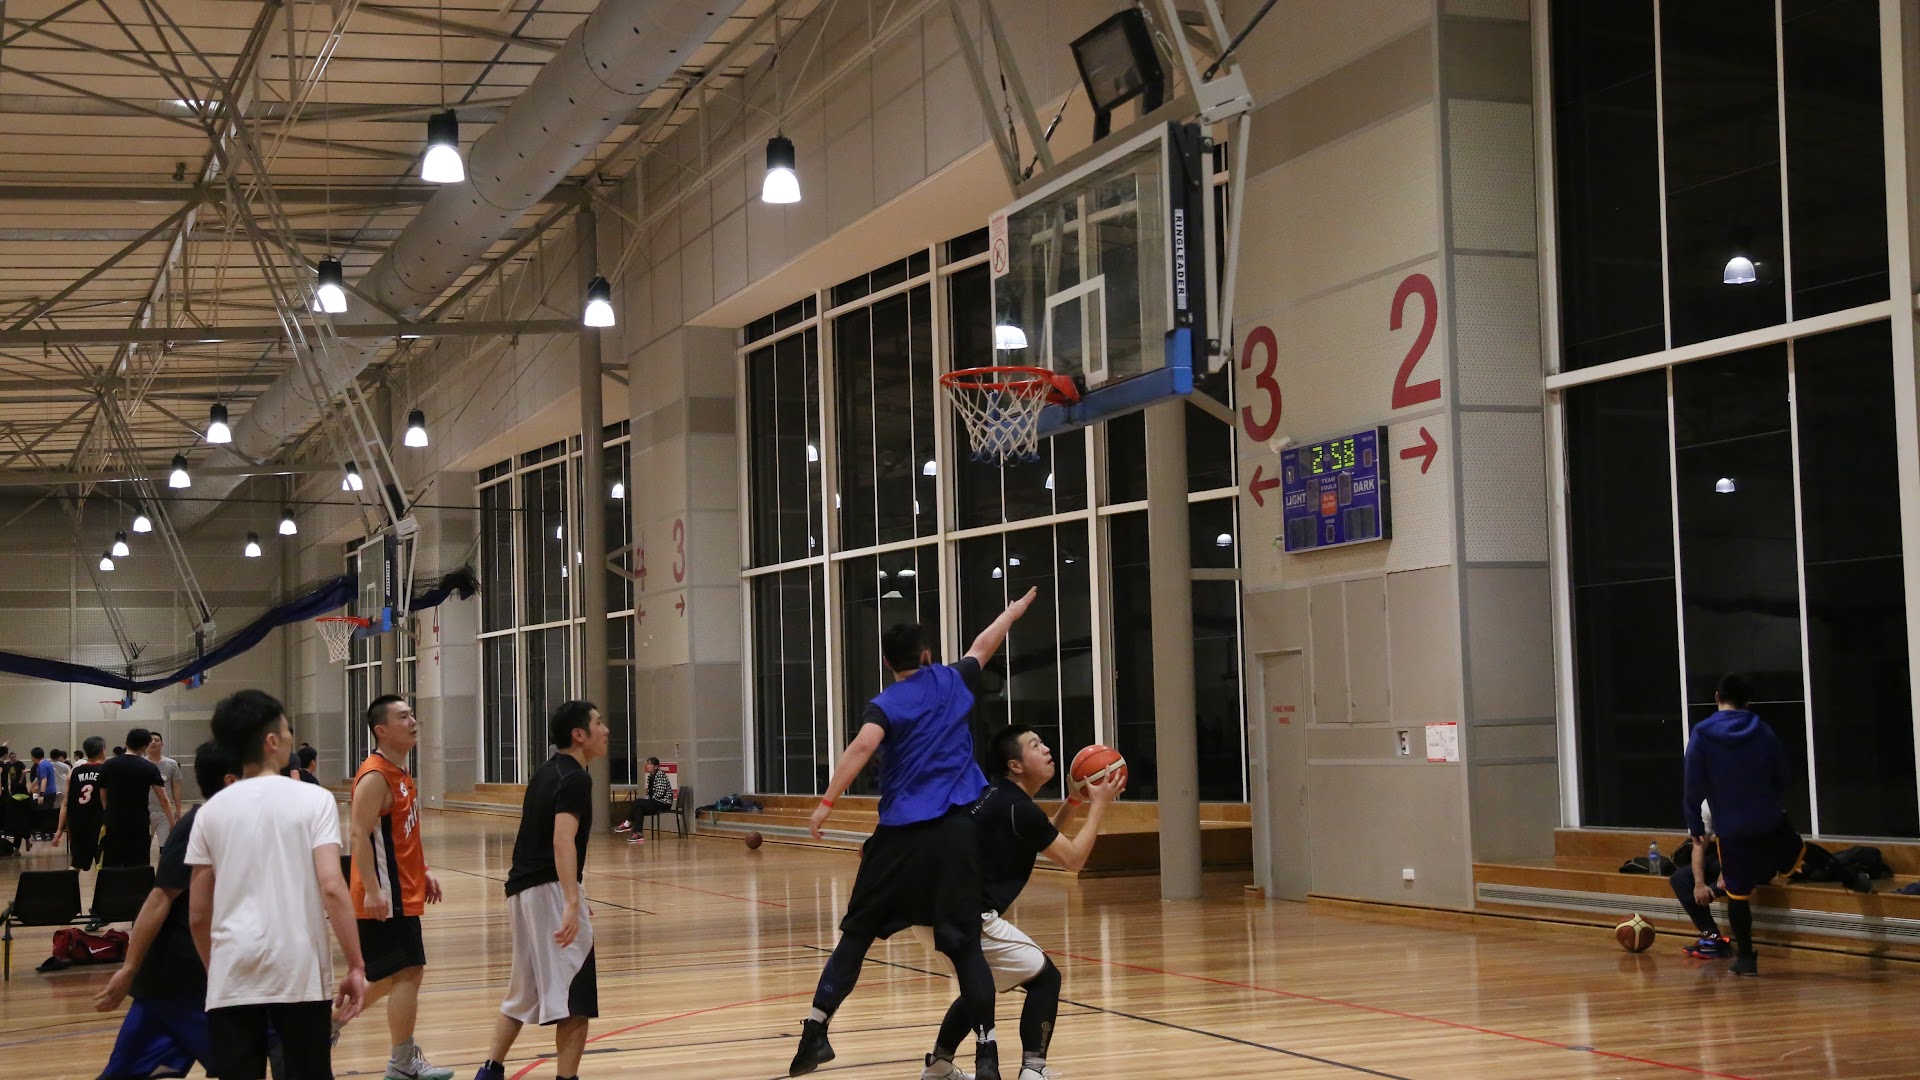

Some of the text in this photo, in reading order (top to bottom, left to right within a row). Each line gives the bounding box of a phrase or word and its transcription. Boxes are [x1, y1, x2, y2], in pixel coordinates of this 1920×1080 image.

[1175, 215, 1185, 295] RINGLEADER
[1390, 273, 1442, 410] 2
[1241, 325, 1282, 442] 3
[1320, 482, 1337, 491] FOULS
[1321, 476, 1336, 484] TEAM
[1353, 479, 1375, 493] DARK
[1286, 493, 1306, 506] LIGHT
[672, 518, 686, 583] 3
[78, 772, 99, 782] WADE
[79, 784, 93, 804] 3
